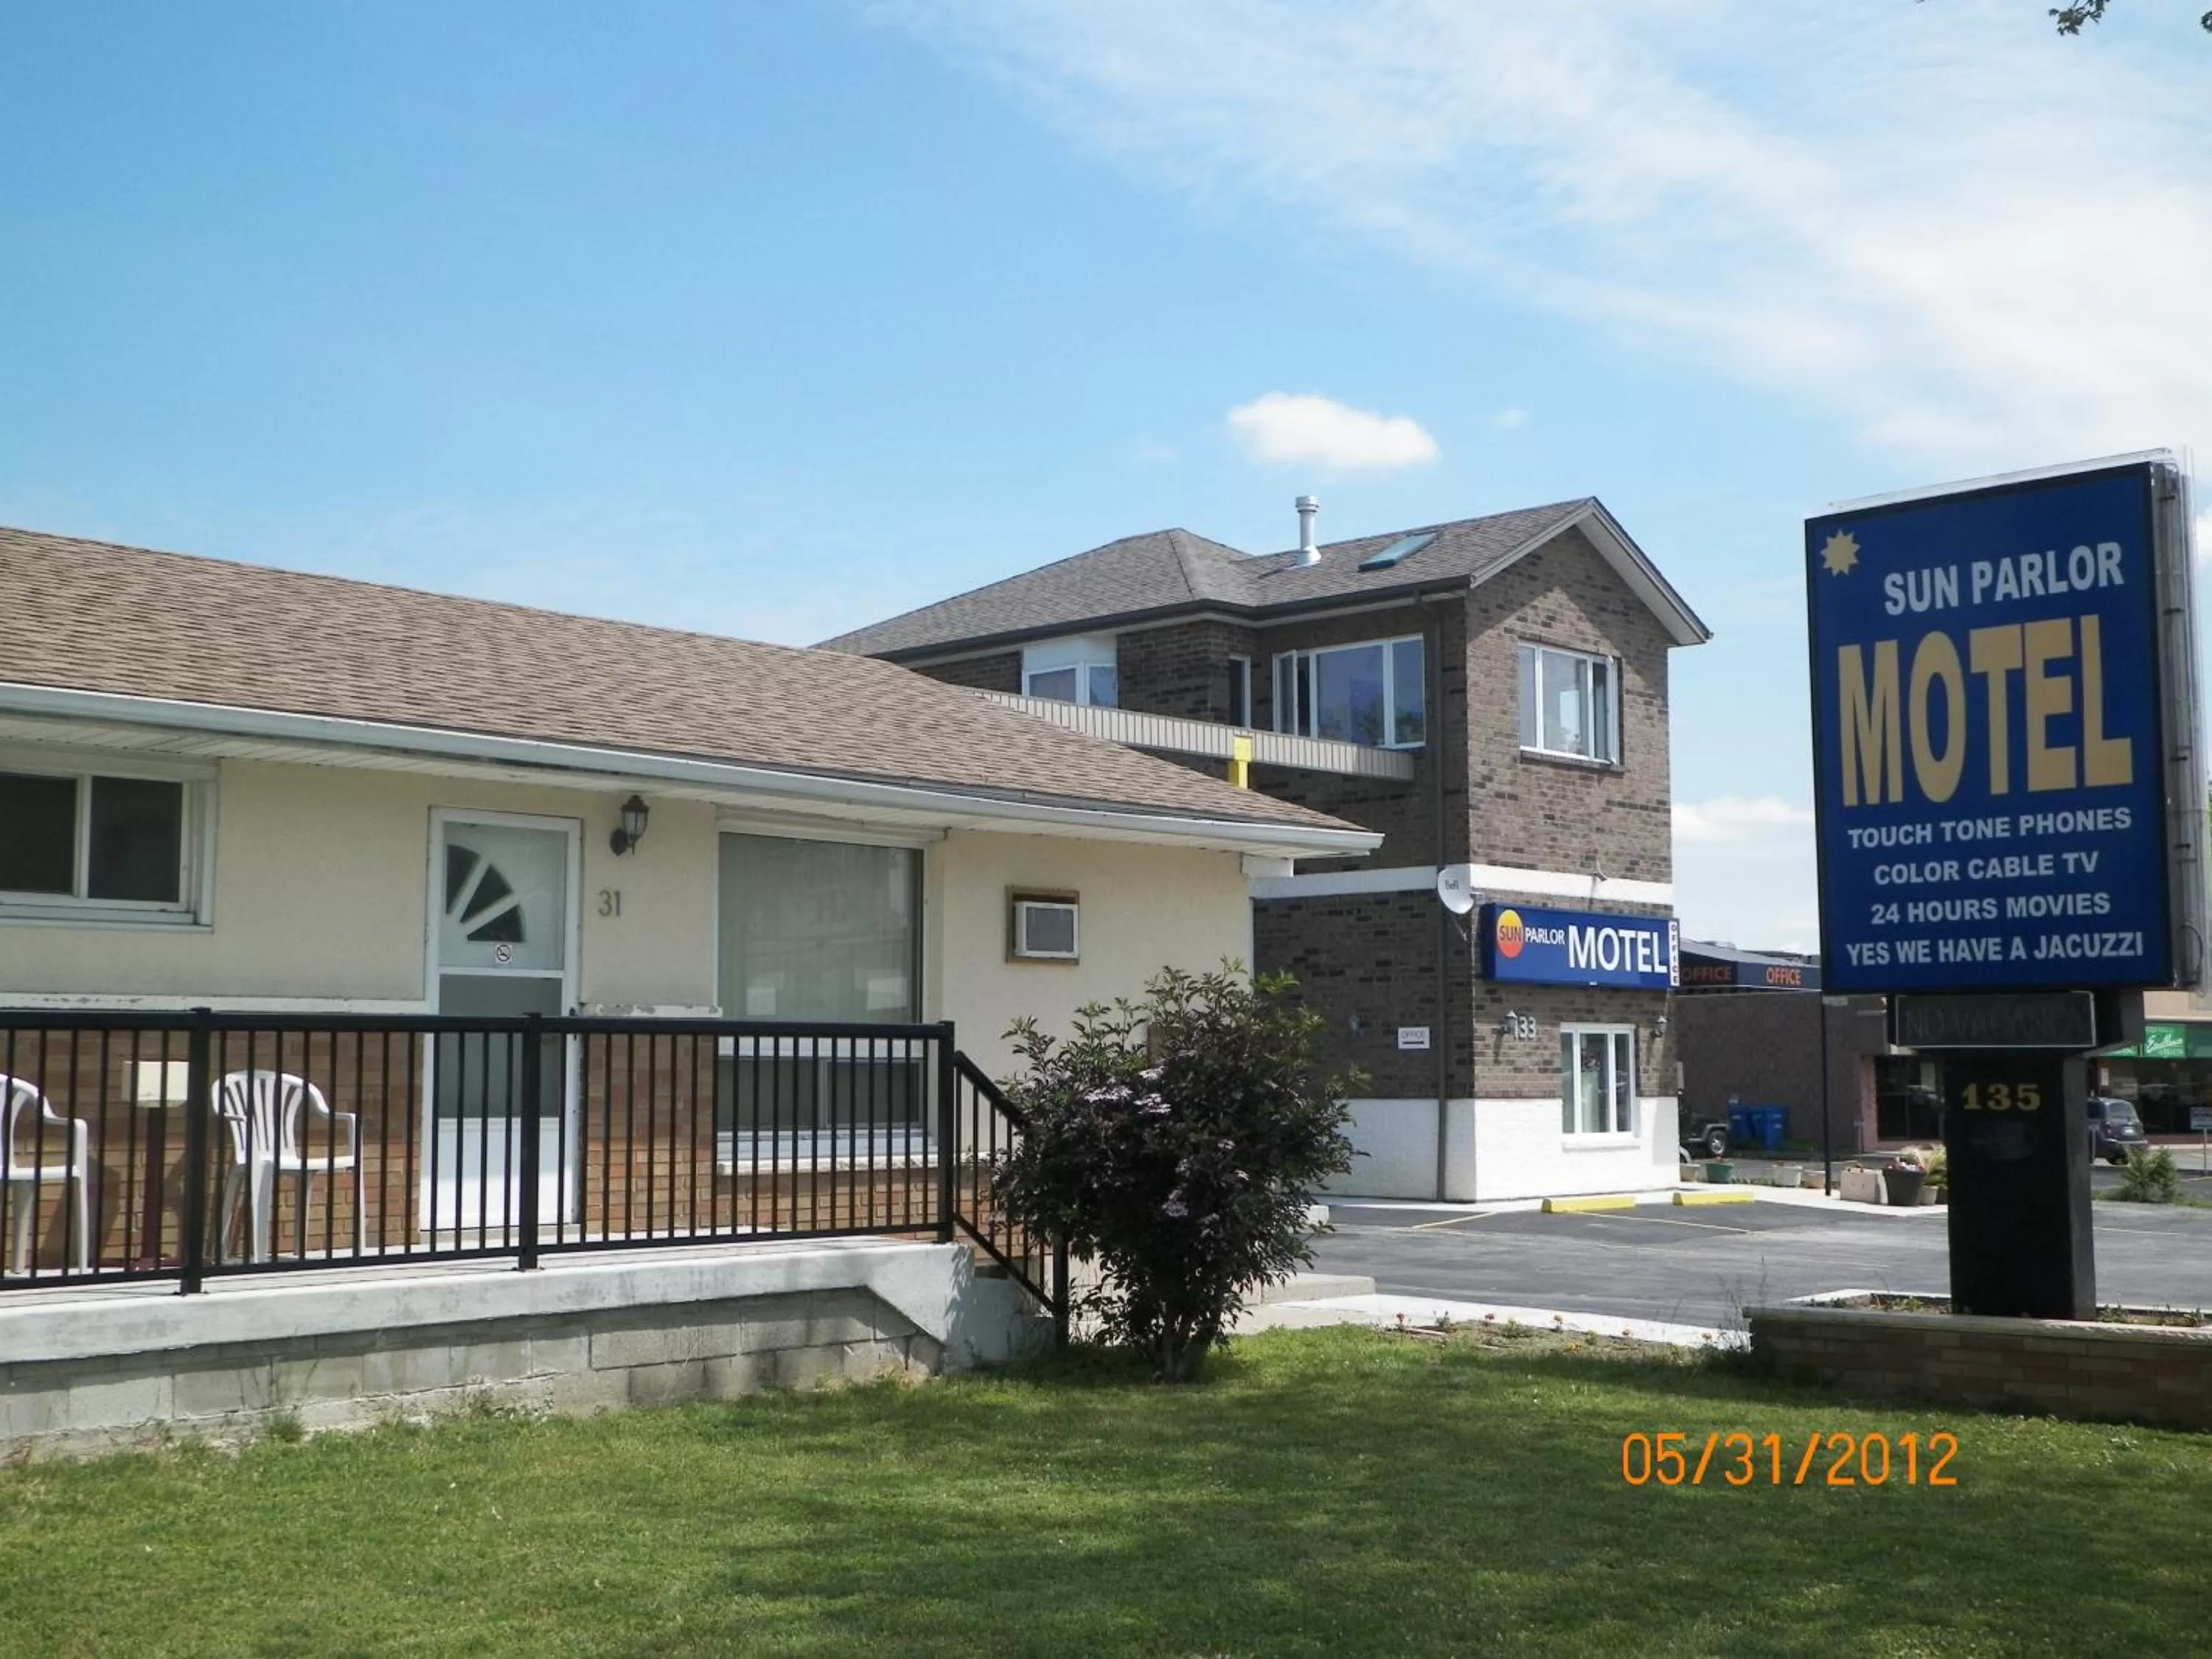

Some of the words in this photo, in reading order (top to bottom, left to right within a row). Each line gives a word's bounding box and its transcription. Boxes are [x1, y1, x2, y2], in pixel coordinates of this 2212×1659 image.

[1884, 565, 1959, 616] SUN
[1972, 541, 2124, 604] PARLOR
[1837, 613, 2134, 807] MOTEL
[1847, 823, 1932, 849] TOUCH
[1940, 817, 2011, 842] TONE
[2020, 807, 2132, 837] PHONES
[1874, 859, 1960, 886] COLOR
[1967, 854, 2053, 881] CABLE
[2062, 851, 2099, 874] TV
[598, 889, 622, 917] 31
[1871, 902, 1899, 925] 24
[1907, 897, 1997, 923] HOURS
[2006, 892, 2111, 919] MOVIES
[1499, 925, 1522, 942] SUN
[1524, 928, 1565, 945] PARLOR
[1568, 925, 1668, 974] MOTEL
[1670, 923, 1678, 984] OFFICE
[1846, 942, 1890, 966] YES
[1896, 940, 1931, 964] WE
[1938, 937, 2003, 962] HAVE
[2009, 936, 2027, 960] A
[2034, 931, 2143, 959] JACUZZI
[1681, 967, 1732, 981] OFFICE
[1767, 967, 1801, 985] OFFICE
[1963, 1083, 2042, 1110] 135
